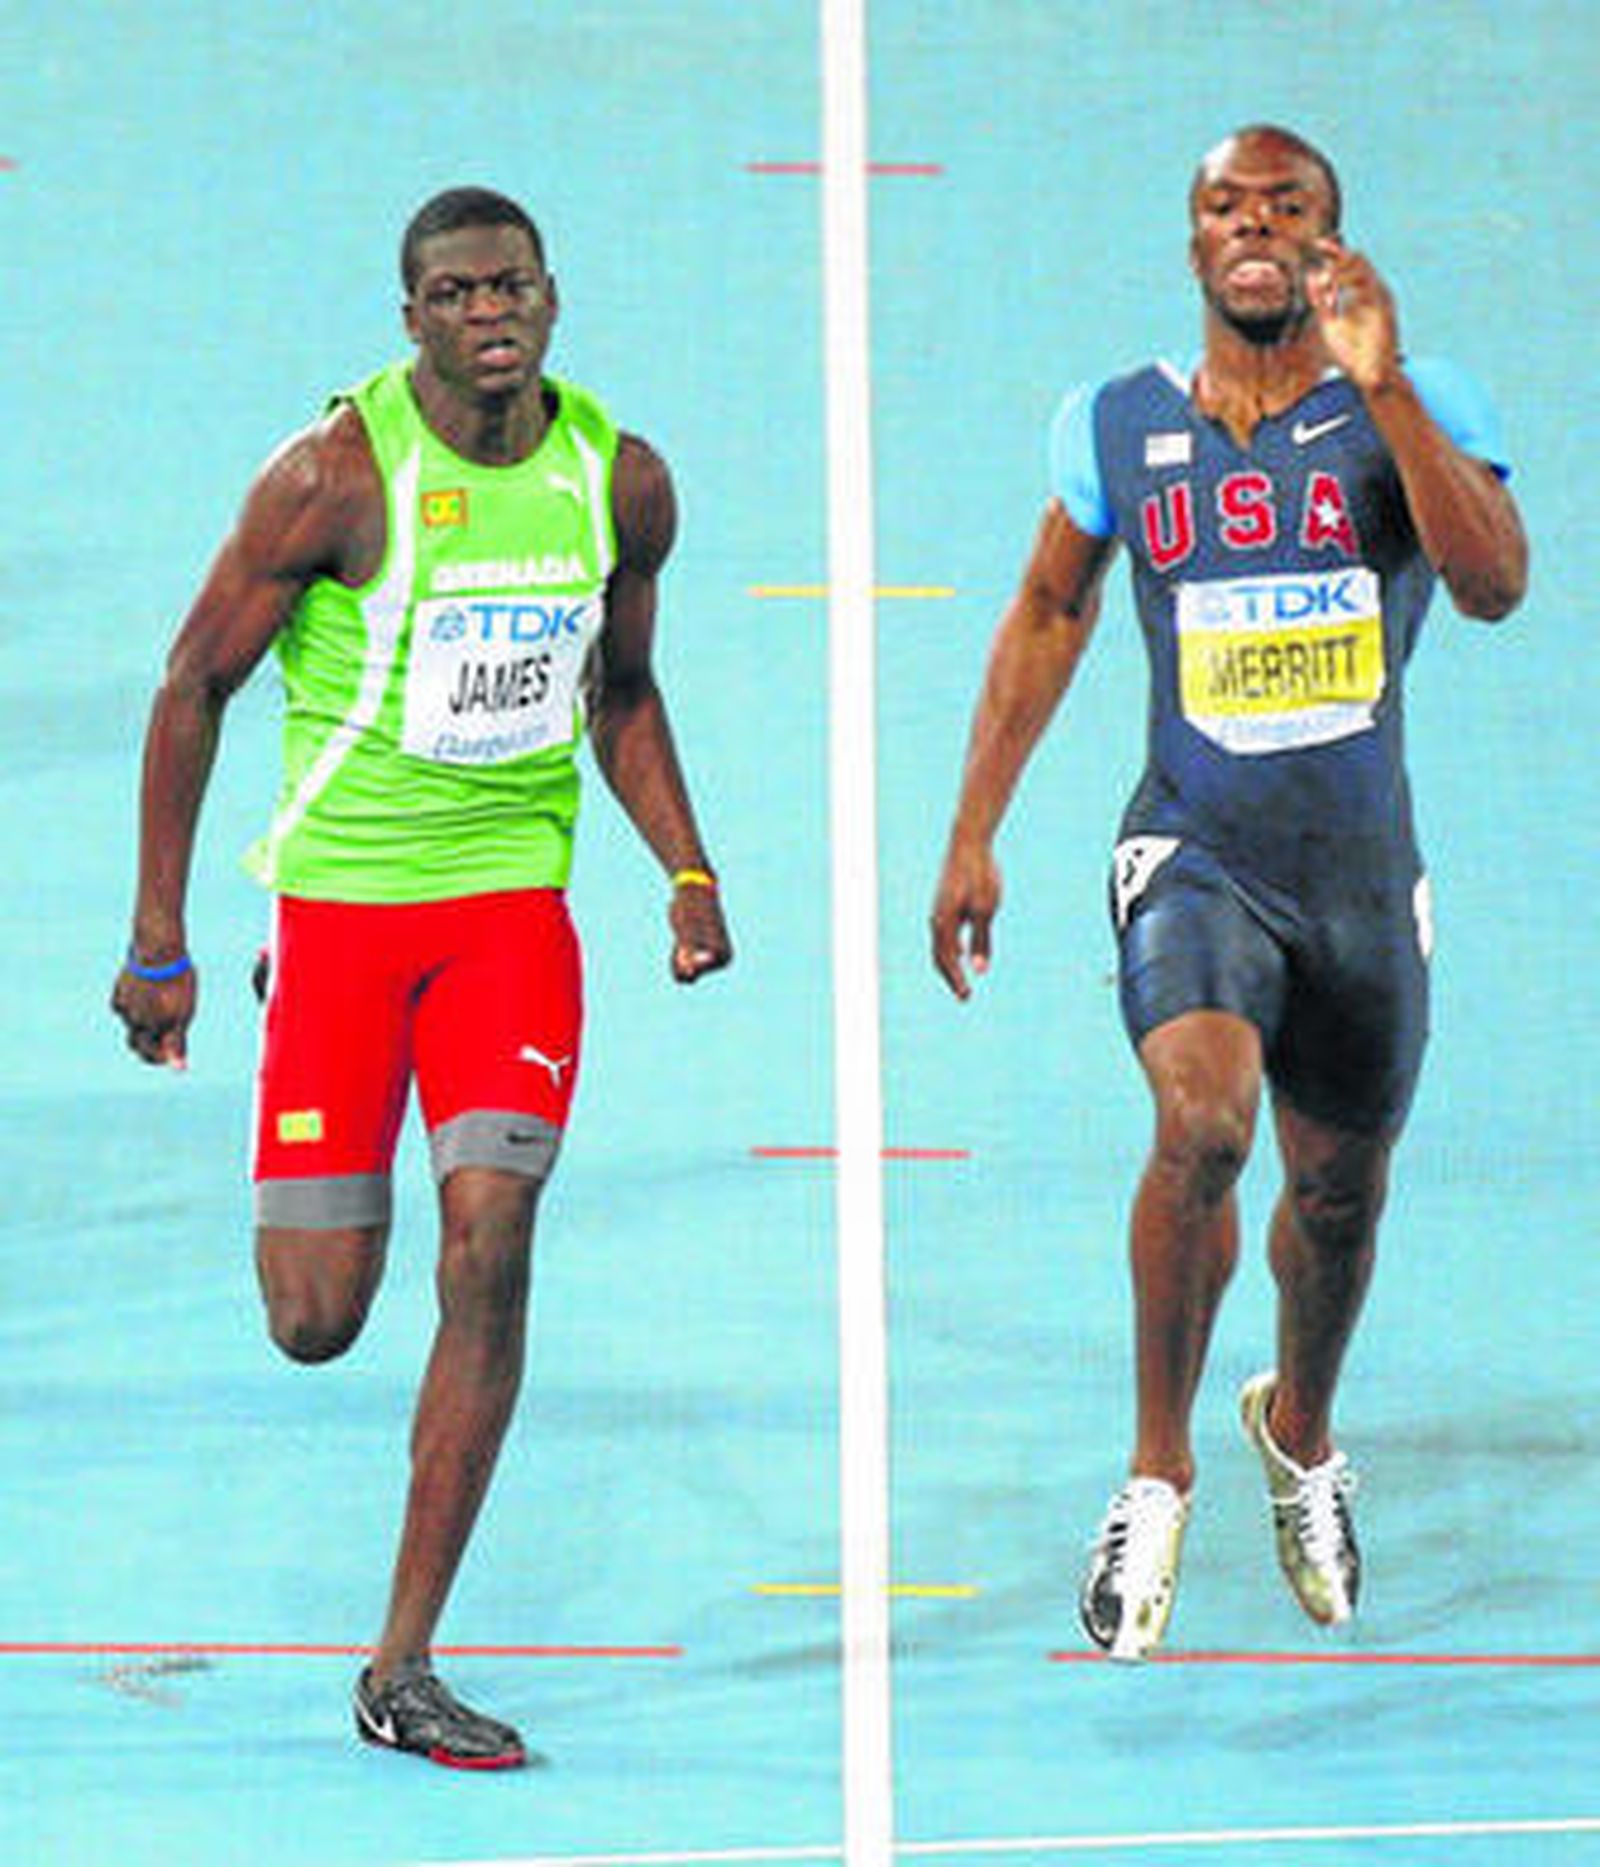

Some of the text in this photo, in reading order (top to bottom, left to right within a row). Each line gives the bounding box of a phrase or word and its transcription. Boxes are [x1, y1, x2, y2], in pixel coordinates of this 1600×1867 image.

[1142, 471, 1358, 571] USA
[431, 556, 586, 591] GRENADA
[1230, 576, 1358, 621] TDK
[470, 603, 587, 641] TDK
[449, 653, 551, 714] JAMES
[1210, 635, 1359, 699] MERRITT
